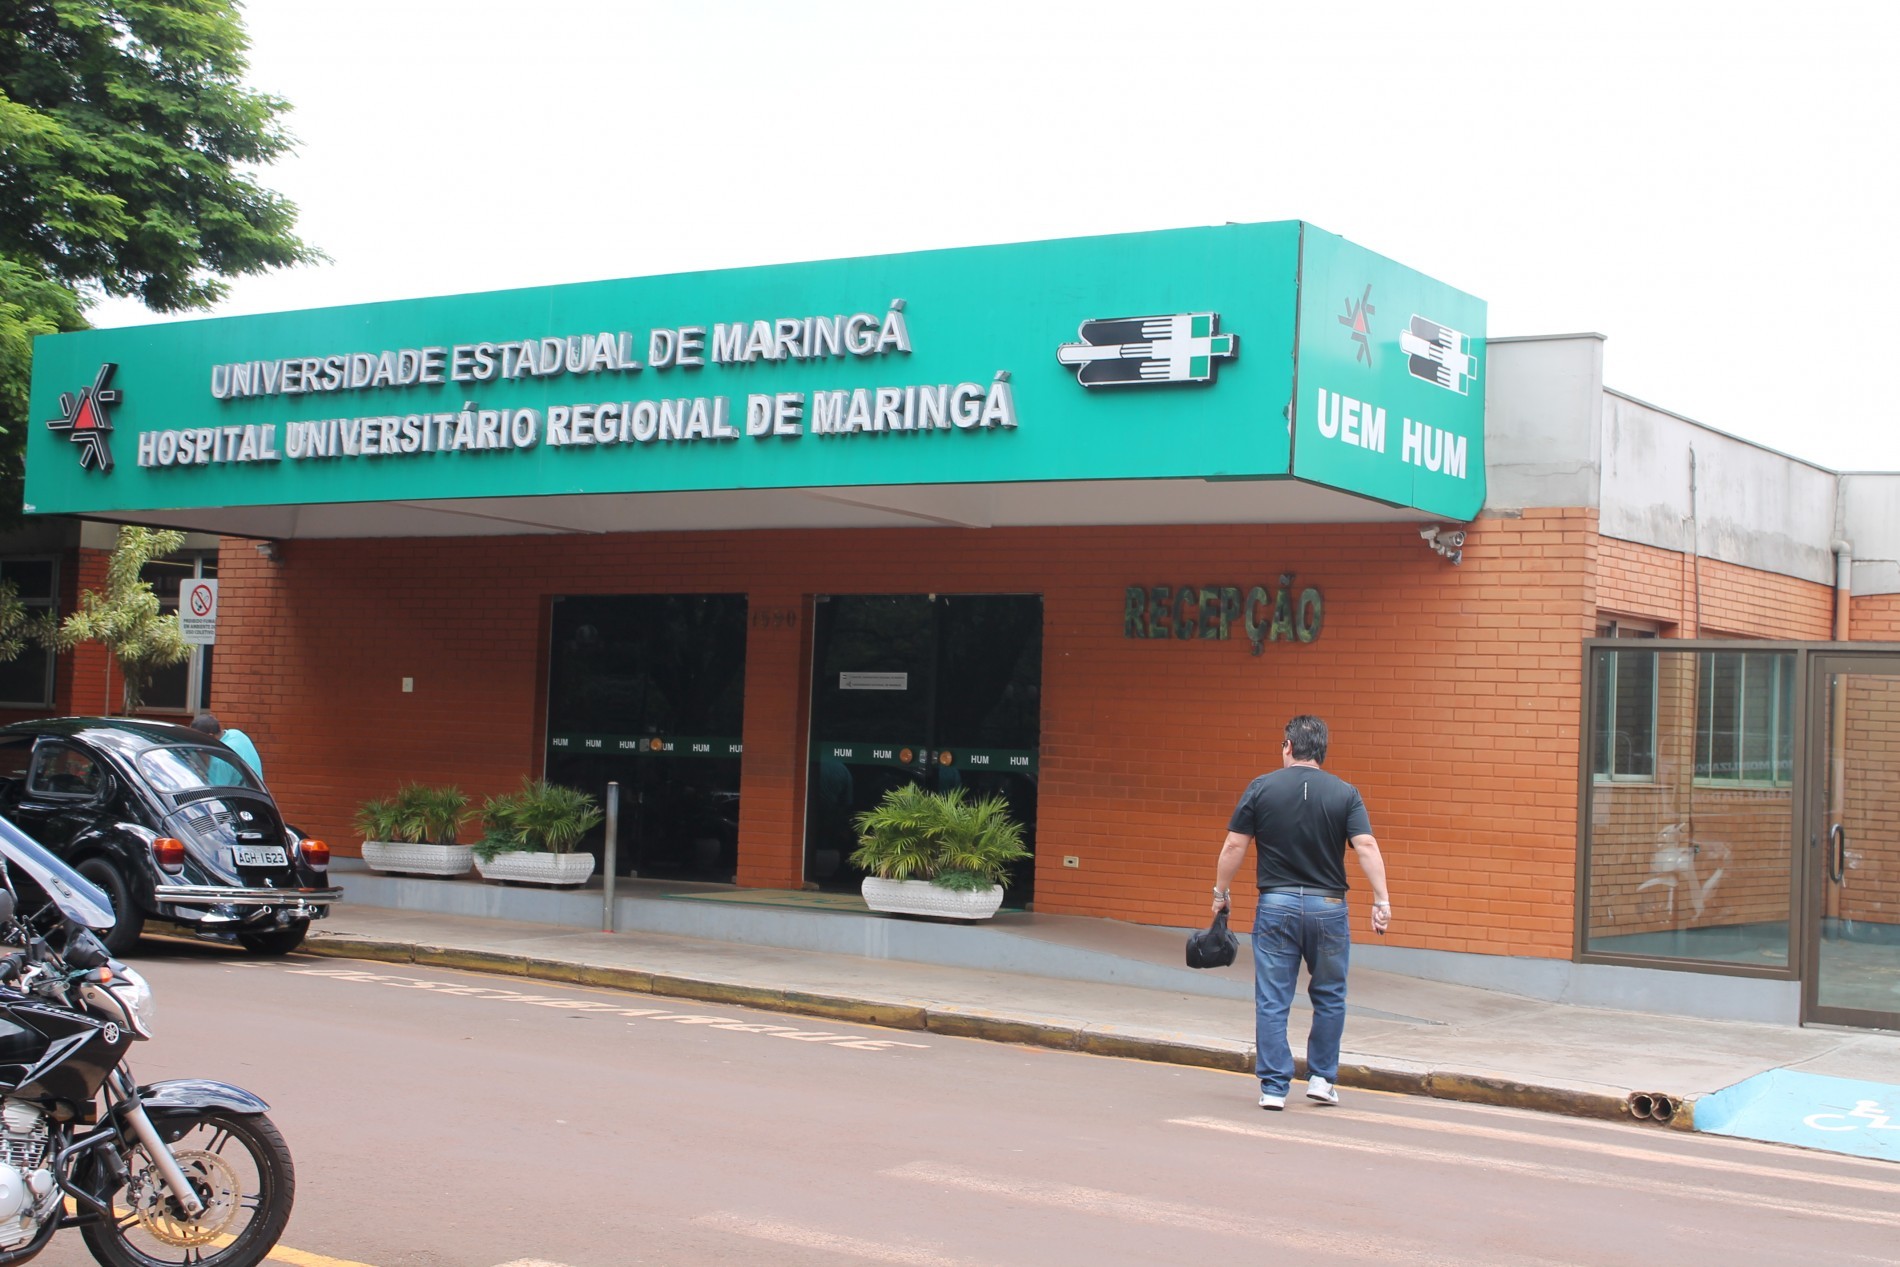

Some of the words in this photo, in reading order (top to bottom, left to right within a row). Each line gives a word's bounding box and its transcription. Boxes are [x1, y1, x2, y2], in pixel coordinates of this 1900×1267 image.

[211, 346, 447, 399] UNIVERSIDADE
[450, 331, 643, 383] ESTADUAL
[649, 326, 706, 369] DE
[712, 298, 912, 364] MARINGÁ
[137, 423, 281, 468] HOSPITAL
[285, 401, 542, 460] UNIVERSITÁRIO
[546, 396, 739, 448] REGIONAL
[746, 392, 804, 437] DE
[811, 370, 1018, 435] MARINGÁ
[1317, 387, 1386, 453] UEM
[1401, 417, 1467, 479] HUM
[1124, 572, 1325, 656] RECEPÇÃO
[552, 738, 569, 746] HUM
[585, 739, 602, 748] HUM
[619, 741, 636, 749] HUM
[662, 743, 674, 751] UM
[692, 744, 710, 752] HUM
[833, 748, 853, 757] HUM
[873, 749, 892, 759] HUM
[970, 755, 990, 764] HUM
[1010, 756, 1029, 766] HUM
[239, 852, 285, 864] AGH-1623
